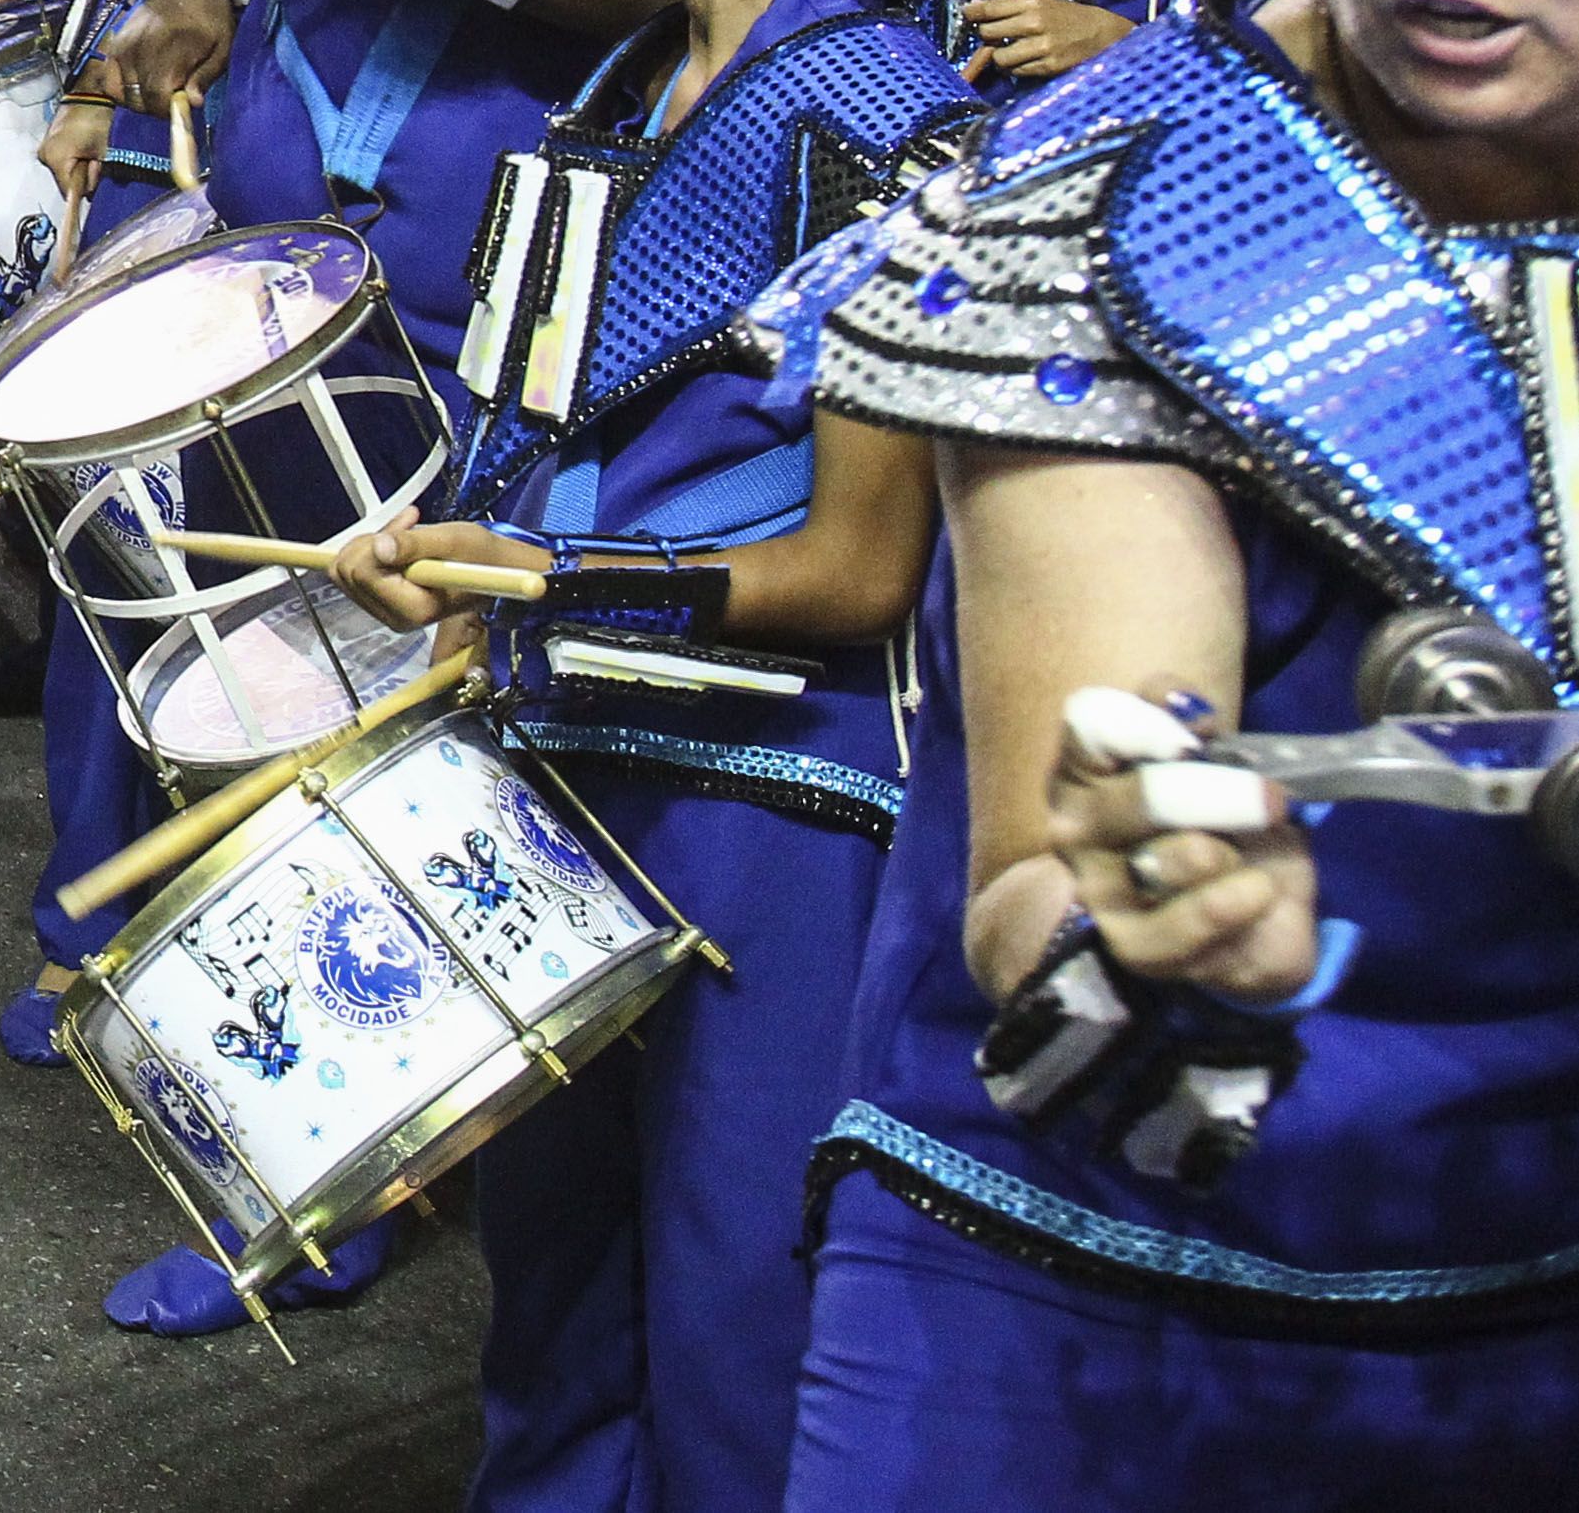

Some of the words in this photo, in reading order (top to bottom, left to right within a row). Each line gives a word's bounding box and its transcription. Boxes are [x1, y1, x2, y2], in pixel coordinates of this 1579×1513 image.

[95, 510, 151, 549] MOCIDAD
[517, 837, 596, 890] MOCIDADE
[299, 886, 355, 954] BATERIA
[312, 983, 411, 1026] MOCIDADE
